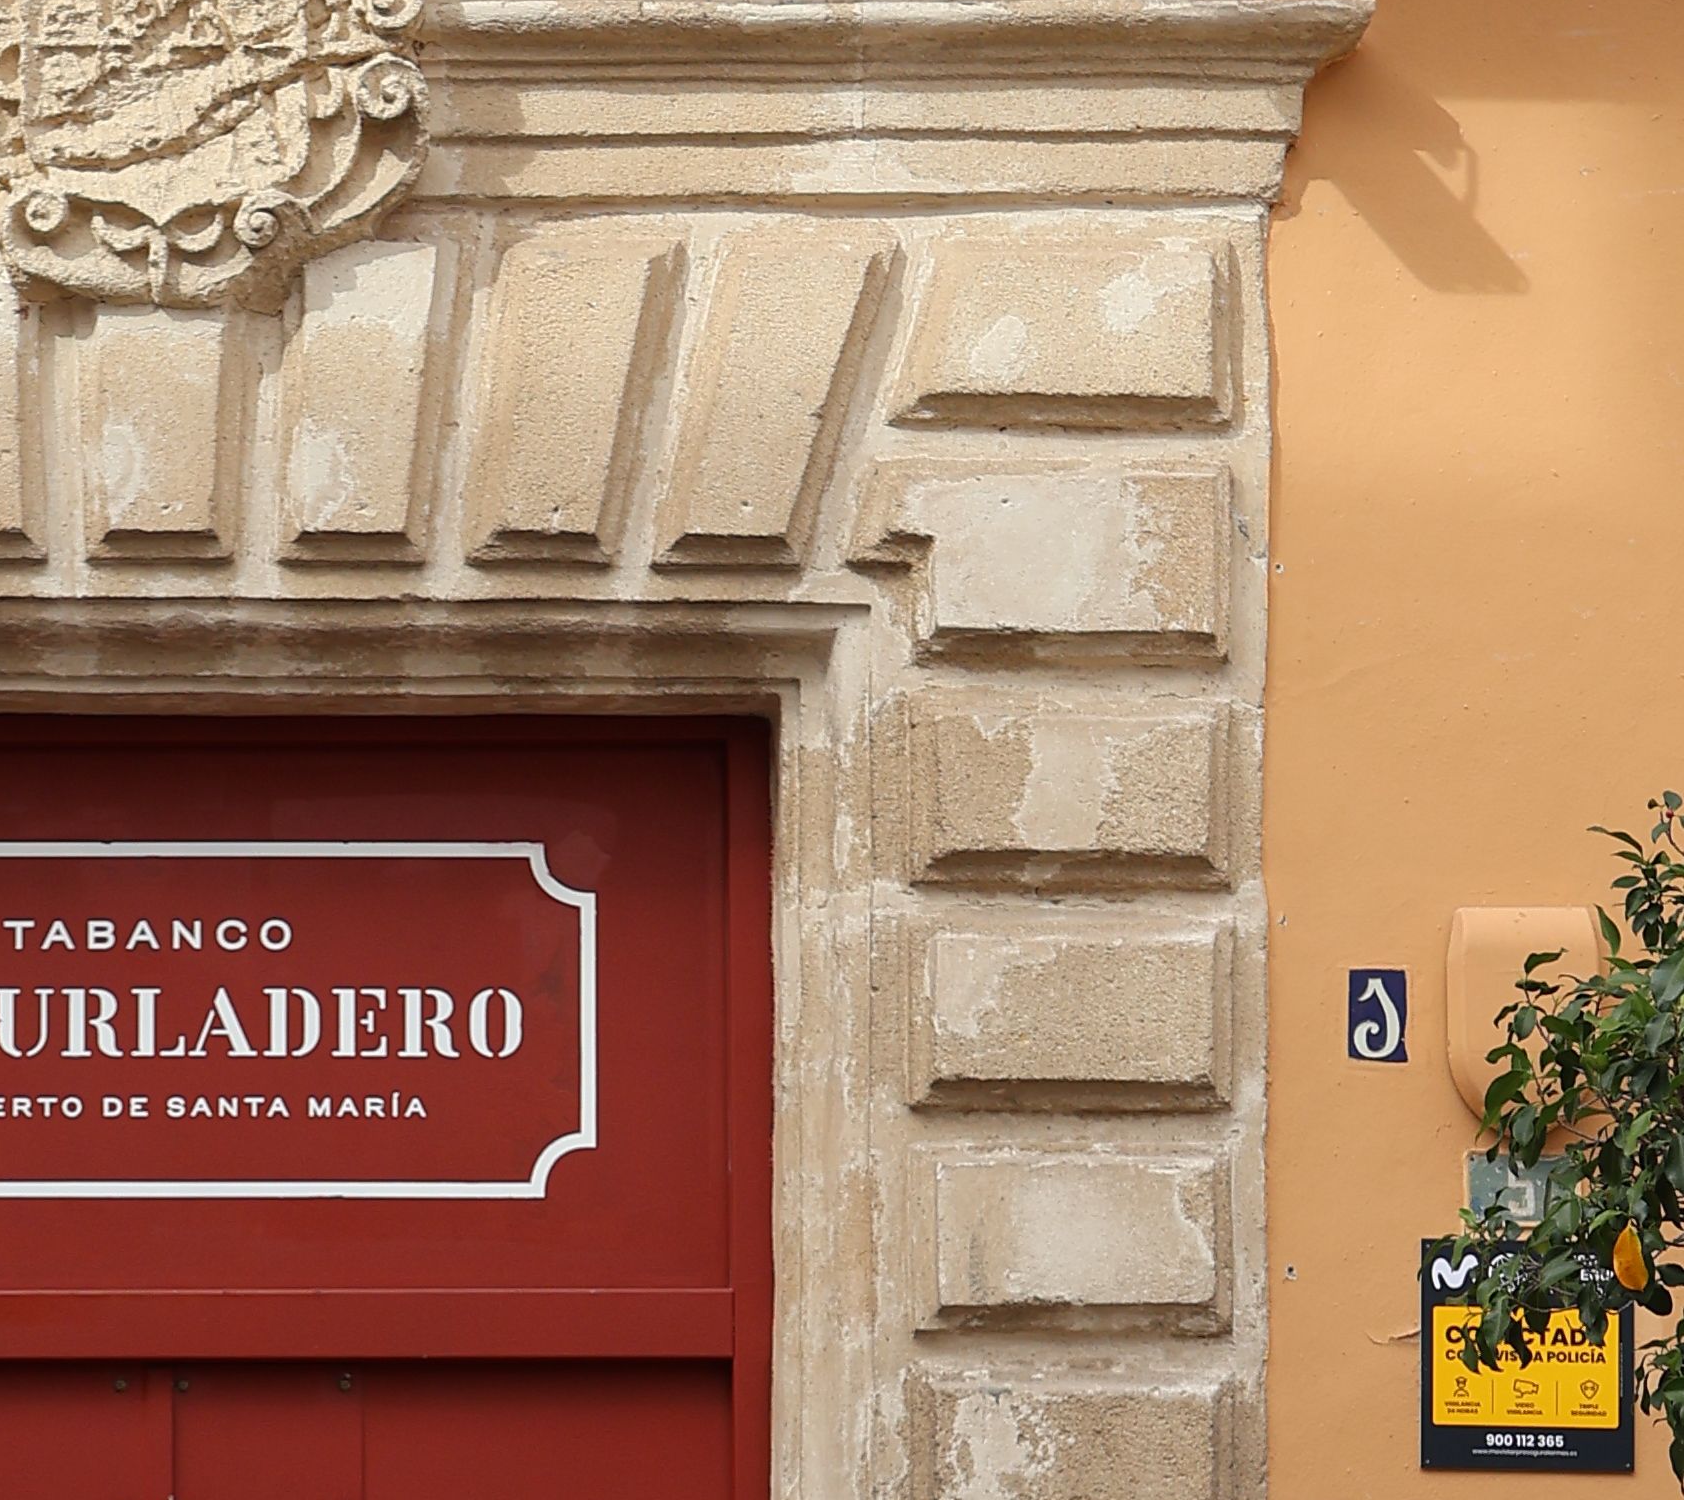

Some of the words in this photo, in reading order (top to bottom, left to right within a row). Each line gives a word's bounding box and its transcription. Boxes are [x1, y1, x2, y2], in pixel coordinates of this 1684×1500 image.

[3, 919, 293, 951] TABANCO
[101, 1096, 150, 1119] DE
[165, 1096, 291, 1119] SANTA
[307, 1091, 428, 1119] MARÍA
[1547, 1348, 1607, 1365] POLICÍA
[1486, 1433, 1513, 1446] 900
[1515, 1434, 1535, 1447] 112
[1537, 1435, 1564, 1448] 365
